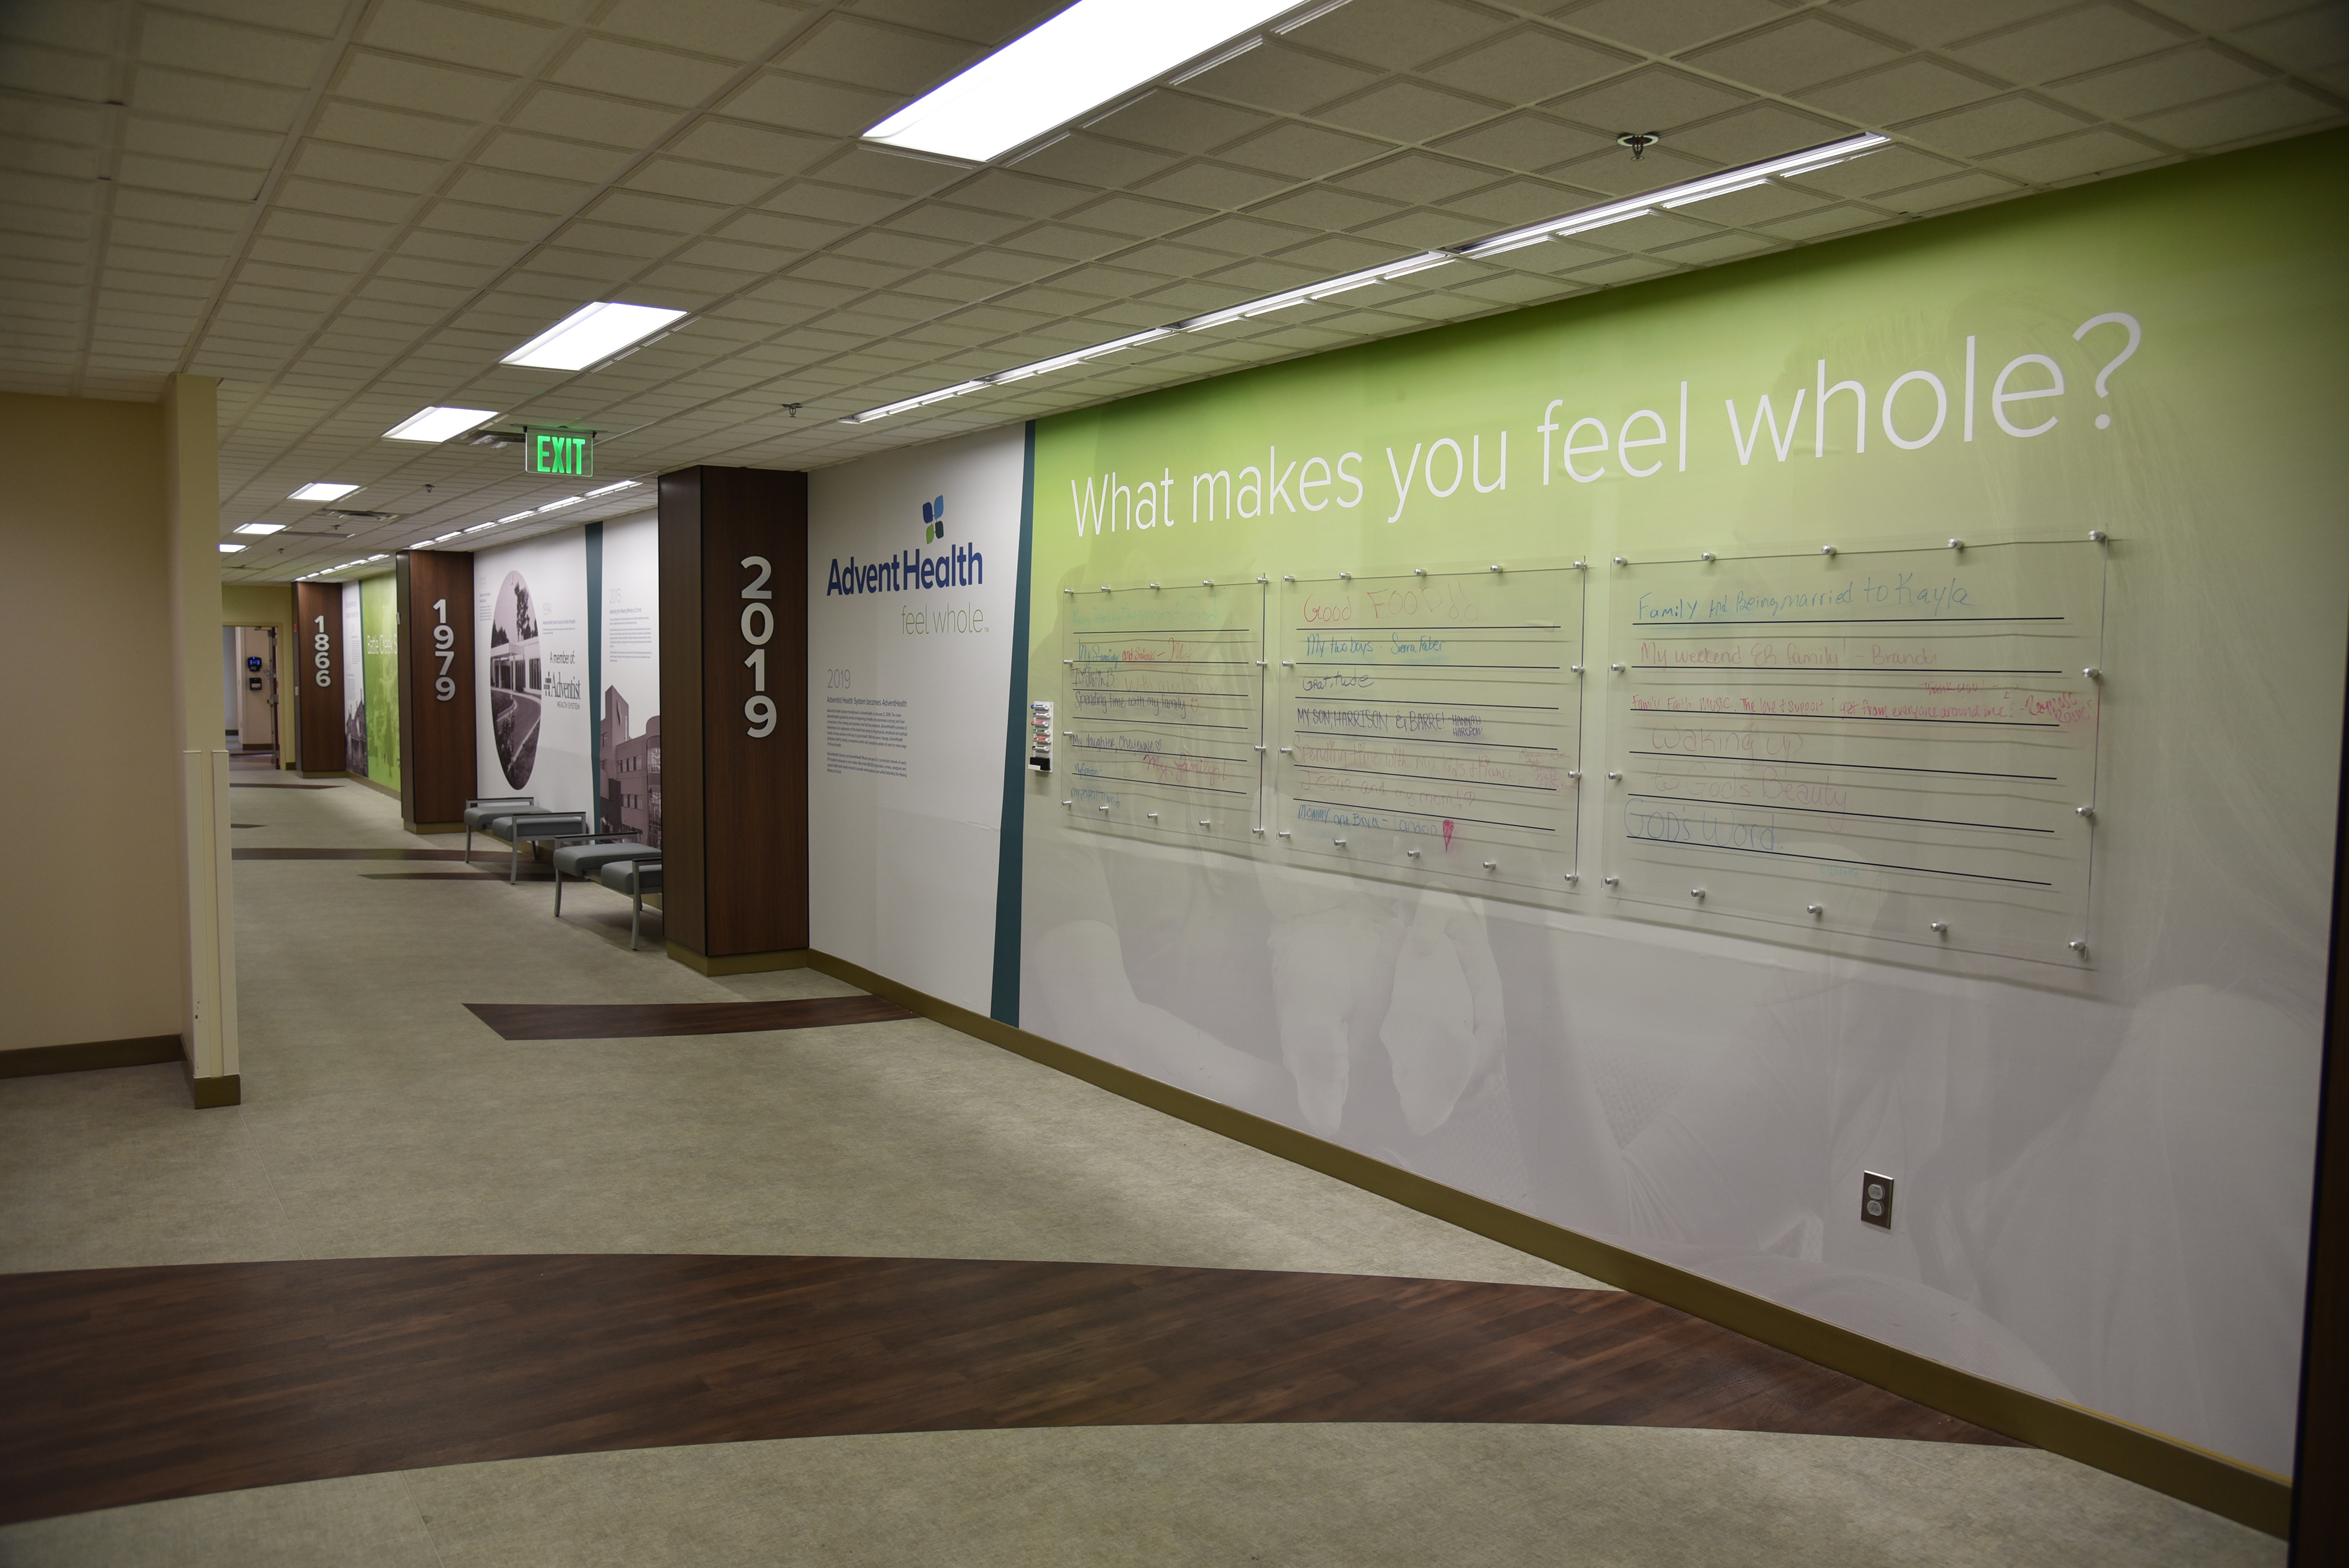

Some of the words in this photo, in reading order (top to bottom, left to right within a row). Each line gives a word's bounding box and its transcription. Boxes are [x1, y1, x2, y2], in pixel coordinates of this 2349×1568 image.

[1071, 467, 1174, 537] What
[1192, 445, 1364, 523] makes
[1386, 431, 1507, 523] you
[1537, 381, 1688, 486] feel
[1725, 312, 2142, 466] whole?
[537, 435, 585, 475] EXIT
[826, 542, 983, 596] AdventHealth
[1304, 593, 1352, 622] Good
[1638, 592, 1698, 620] Family
[1735, 590, 1778, 615] Being
[1778, 581, 1855, 608] married
[1863, 577, 1890, 602] to
[1895, 573, 1972, 617] Kayla
[901, 604, 929, 634] feel
[314, 615, 331, 687] 1866
[432, 599, 456, 701] 1979
[549, 652, 553, 664] A
[554, 651, 570, 664] member
[740, 555, 777, 738] 2019
[1122, 650, 1133, 661] and
[1307, 634, 1325, 658] My
[1330, 636, 1348, 654] two
[1350, 636, 1373, 656] boys
[1390, 632, 1417, 655] Sierra
[1640, 642, 1668, 671] My
[1675, 645, 1742, 664] weekend
[551, 671, 581, 700] Adventist
[827, 668, 851, 689] 2019
[854, 697, 866, 706] System
[867, 698, 881, 707] becomes
[882, 699, 907, 708] AdventHealth
[1075, 691, 1107, 714] Spending
[1110, 693, 1126, 709] time
[1128, 695, 1145, 708] with
[1146, 697, 1160, 716] my
[1162, 694, 1186, 719] family
[1740, 697, 1756, 713] The
[1761, 697, 1776, 713] love
[1860, 700, 1890, 718] from
[1891, 705, 1938, 721] everyone
[1940, 703, 1980, 718] around
[1297, 707, 1310, 727] MY
[1313, 708, 1332, 730] SON,
[1072, 734, 1083, 749] My
